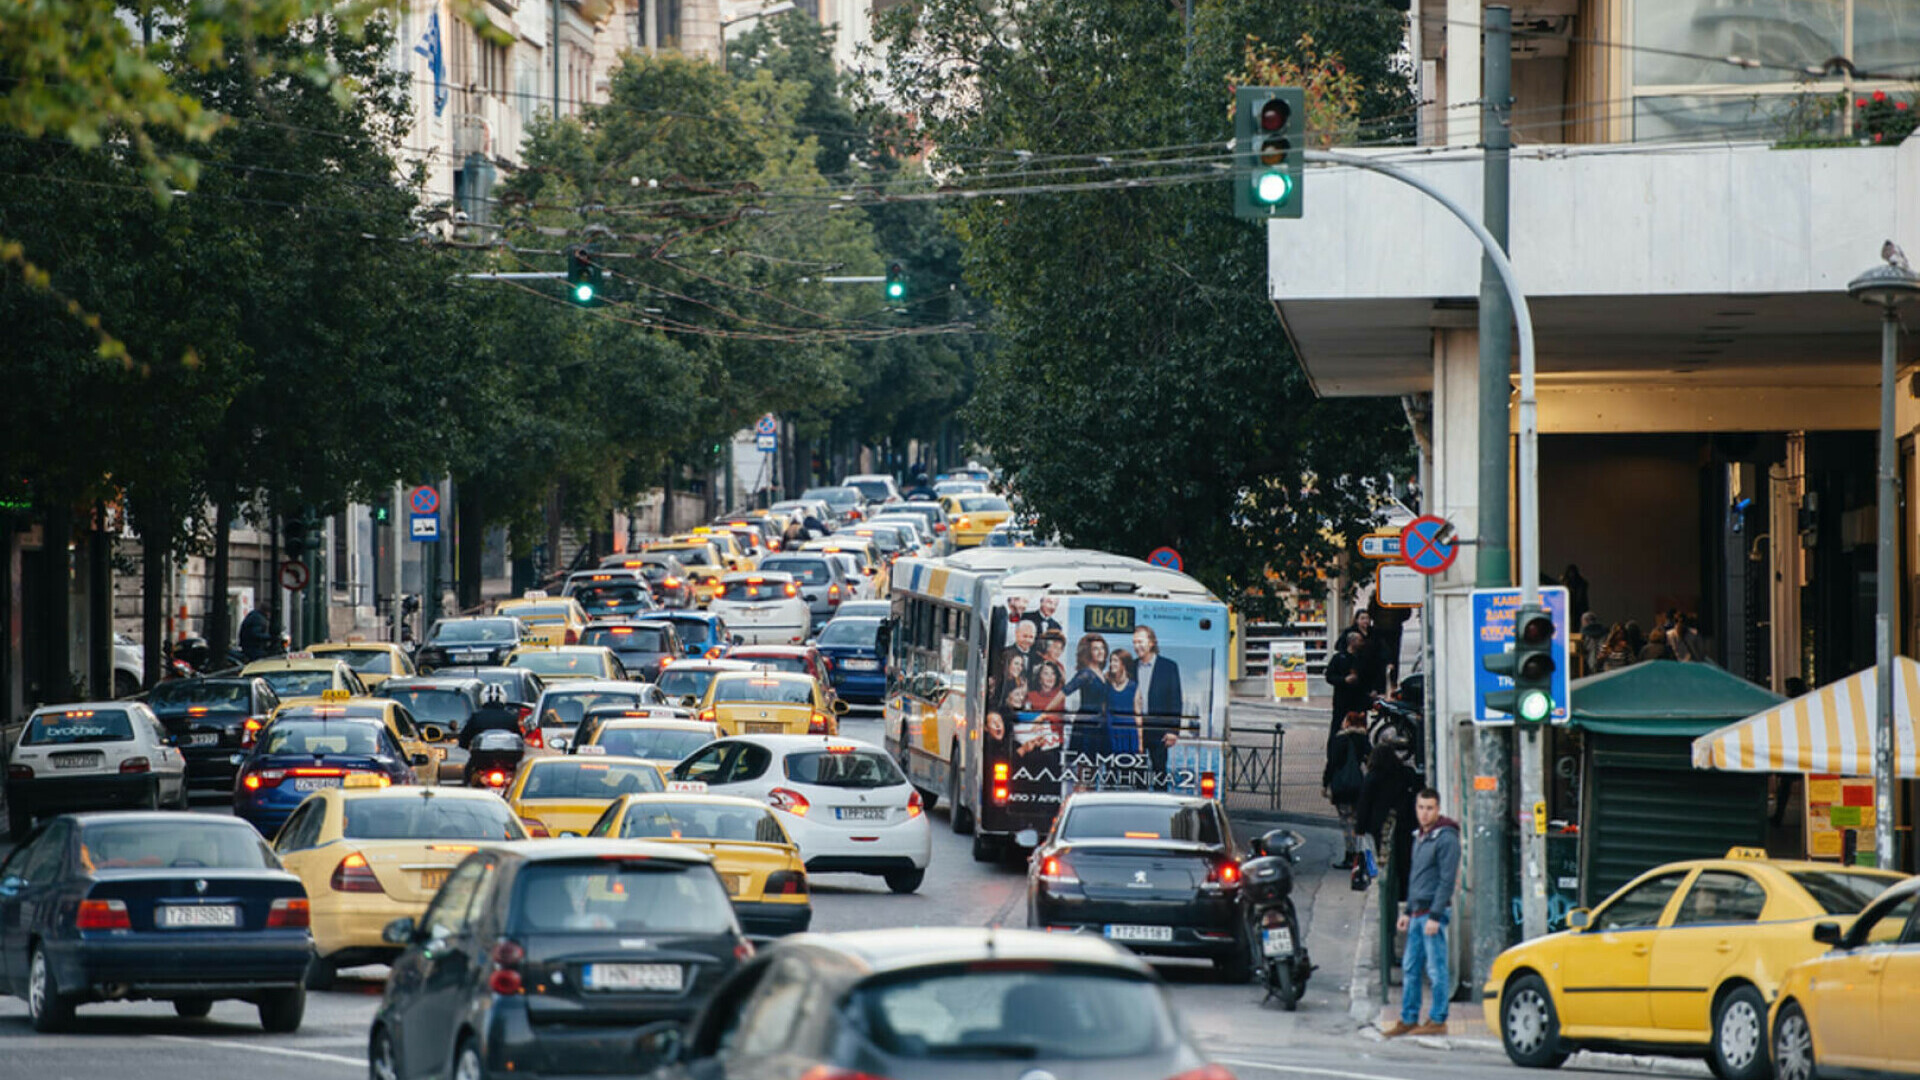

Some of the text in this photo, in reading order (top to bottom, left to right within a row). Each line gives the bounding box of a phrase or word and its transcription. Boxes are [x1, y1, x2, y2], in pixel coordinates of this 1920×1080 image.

[1092, 607, 1129, 628] 040
[47, 726, 106, 736] brother
[1060, 751, 1149, 768] ΓΑΜΟΣ
[1178, 771, 1196, 788] 2
